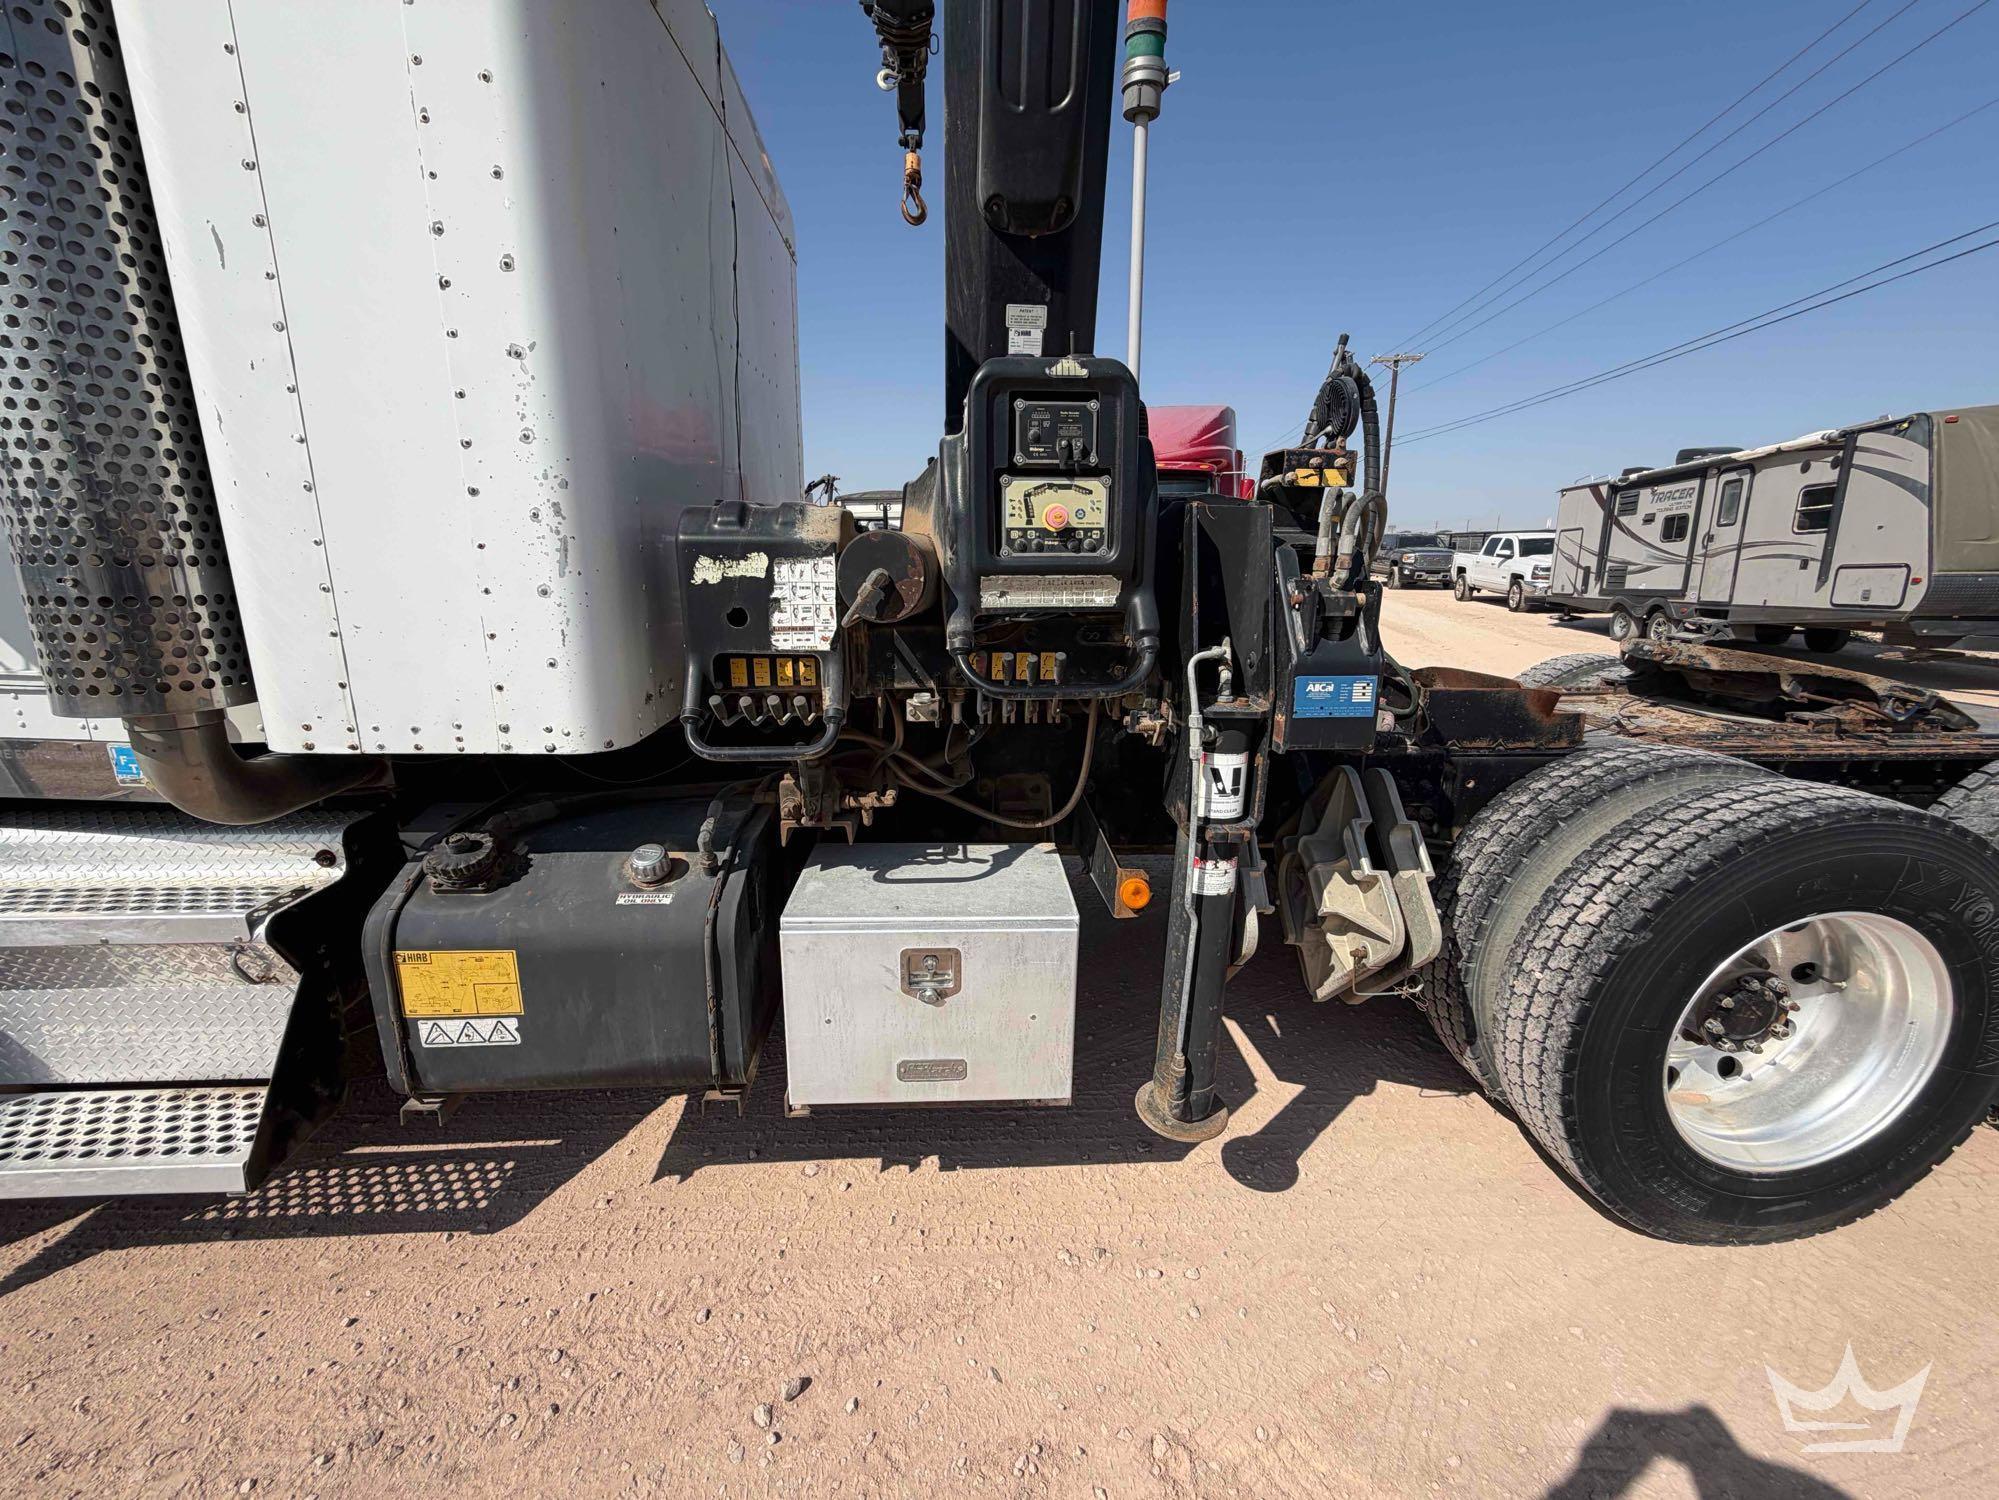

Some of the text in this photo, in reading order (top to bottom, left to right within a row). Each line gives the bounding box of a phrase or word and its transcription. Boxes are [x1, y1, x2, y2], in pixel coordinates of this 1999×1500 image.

[1651, 487, 1696, 504] TRACER
[1306, 683, 1335, 692] AllCal
[407, 952, 428, 962] HIAB
